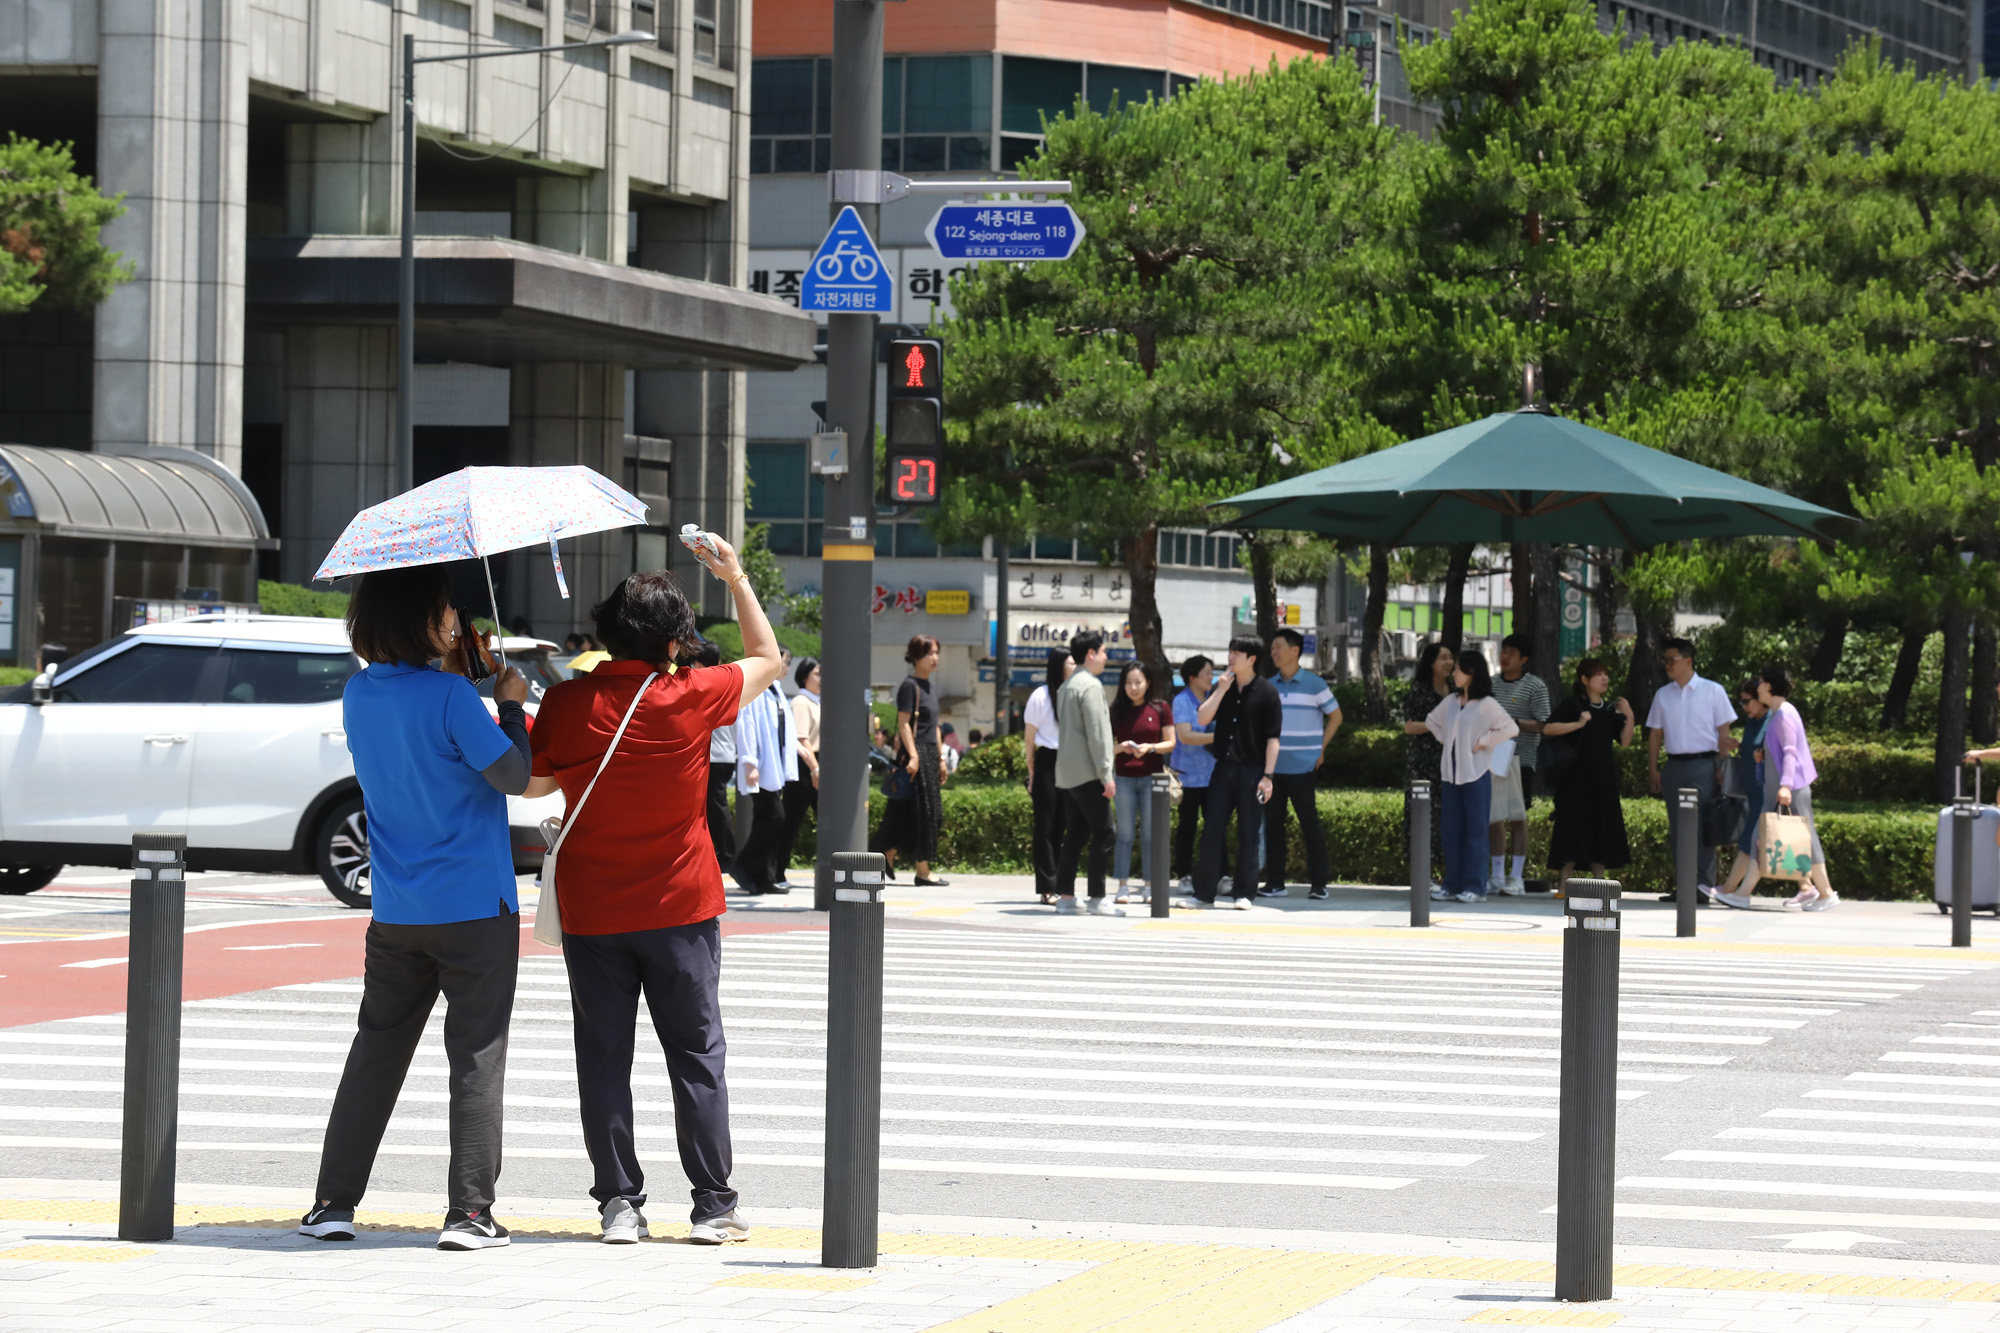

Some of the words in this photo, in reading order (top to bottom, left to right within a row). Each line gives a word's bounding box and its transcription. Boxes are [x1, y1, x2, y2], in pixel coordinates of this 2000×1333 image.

[975, 210, 1036, 227] 세종대로
[945, 226, 966, 238] 122
[969, 230, 1041, 243] Sejong-daero
[1045, 226, 1067, 238] 118
[814, 292, 877, 308] 자전거횡단
[898, 459, 936, 498] 27
[1021, 623, 1069, 643] Office
